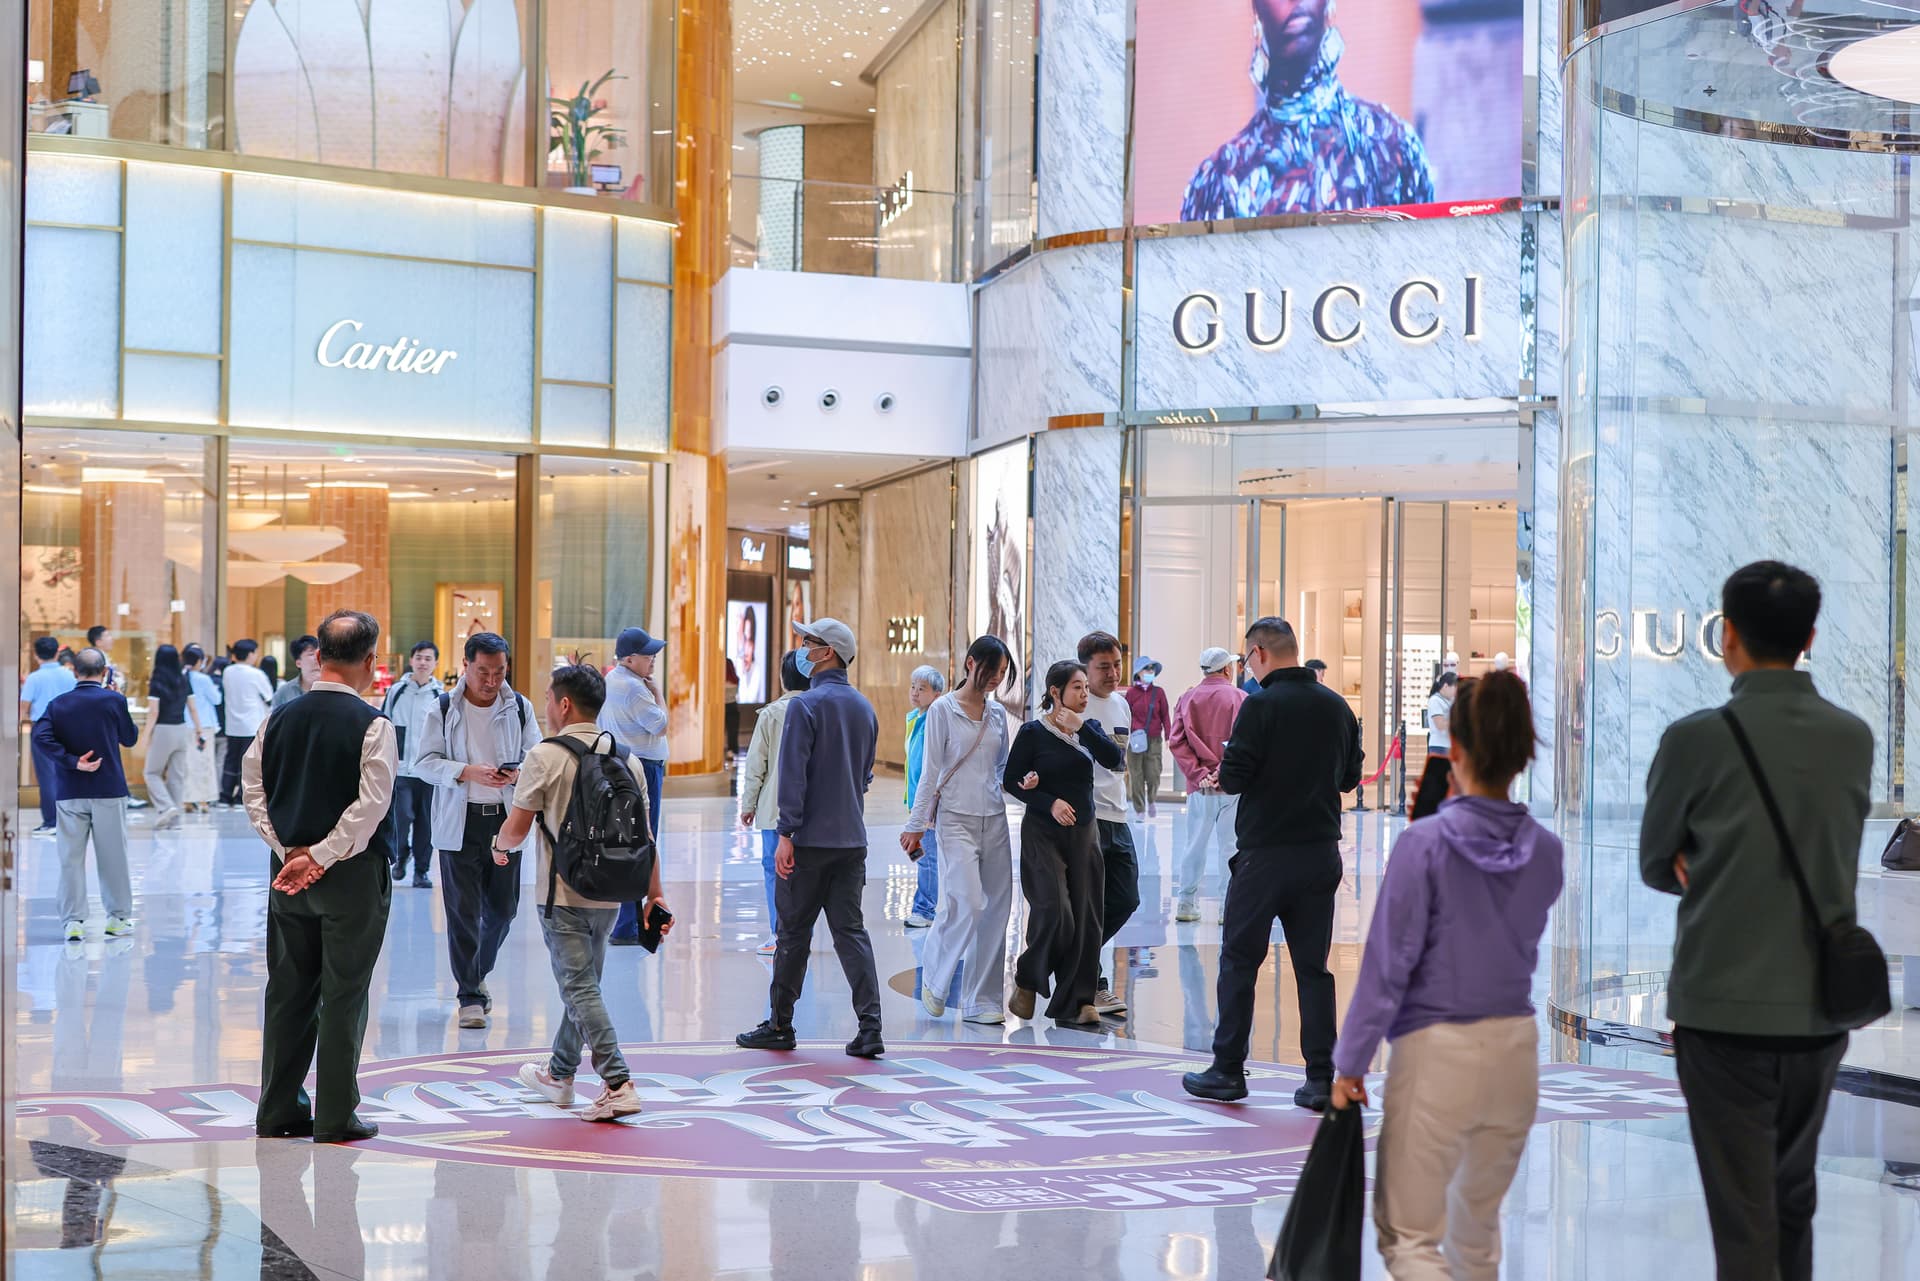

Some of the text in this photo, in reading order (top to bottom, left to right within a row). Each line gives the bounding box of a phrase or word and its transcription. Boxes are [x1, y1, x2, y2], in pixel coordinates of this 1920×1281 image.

[1172, 277, 1477, 349] GUCCI
[317, 319, 458, 375] Cartier
[913, 1165, 1303, 1190] CHINA DUTY FREE
[1083, 1174, 1302, 1207] cdf
